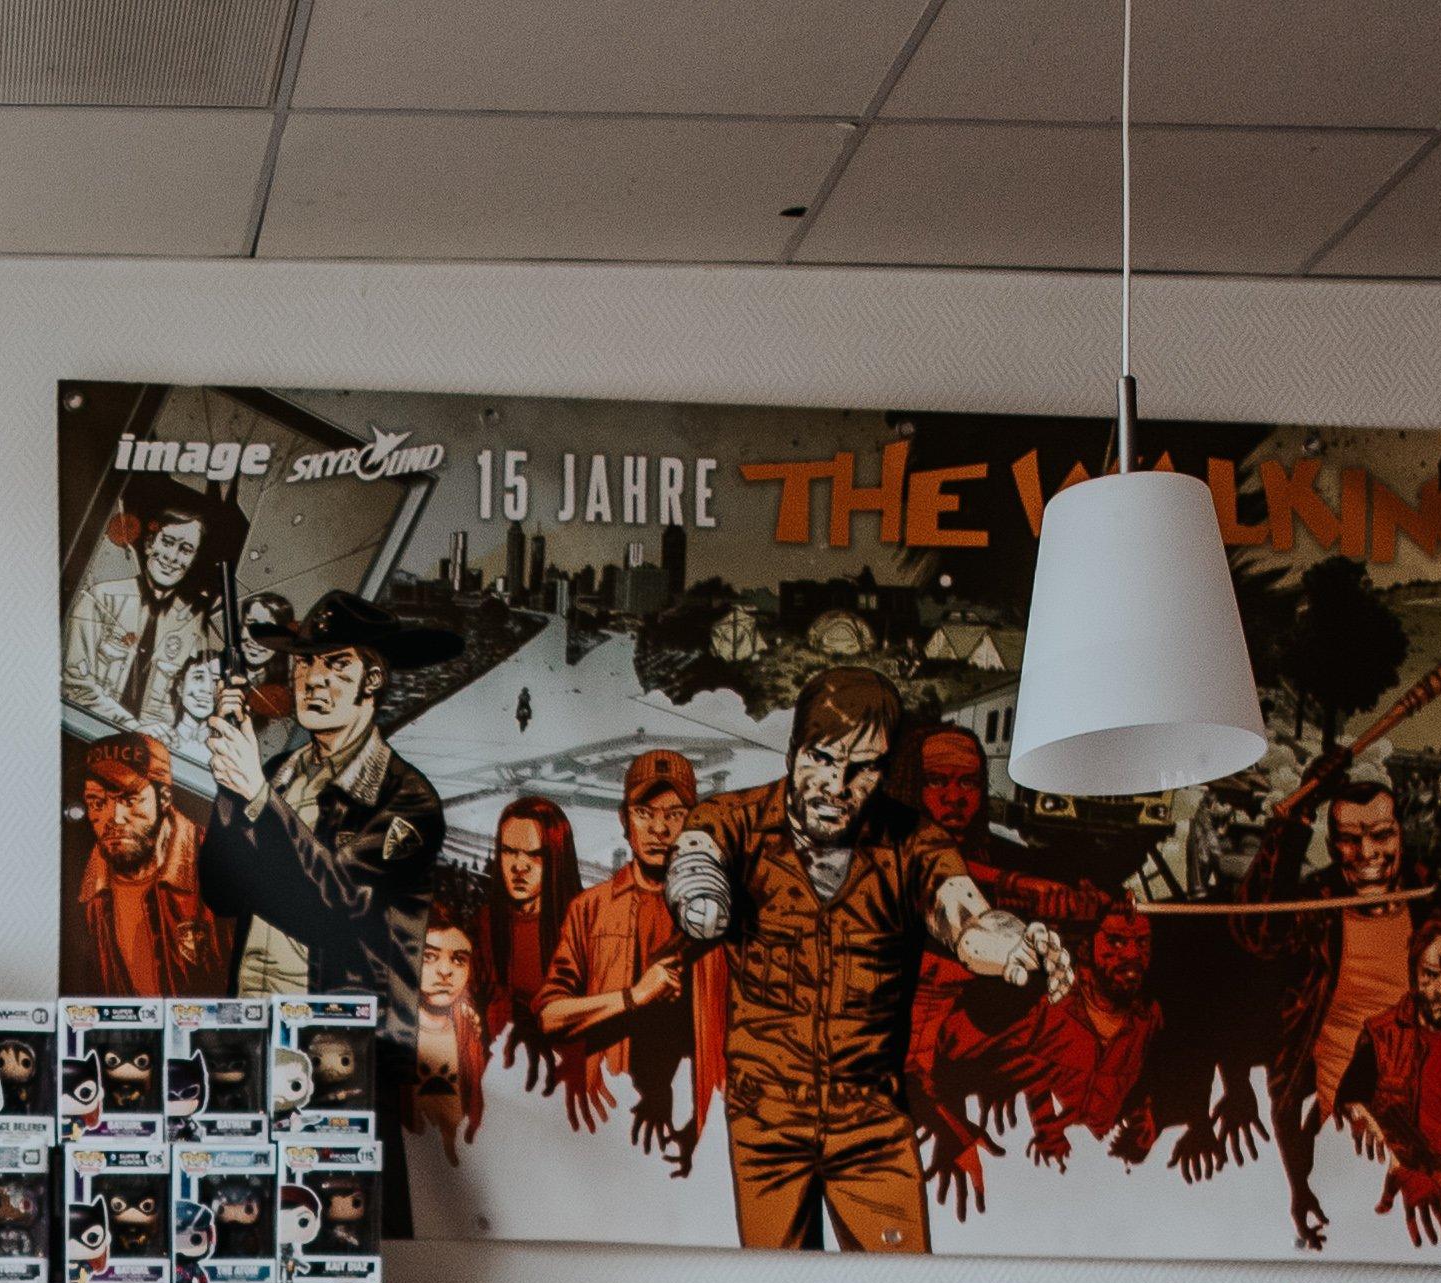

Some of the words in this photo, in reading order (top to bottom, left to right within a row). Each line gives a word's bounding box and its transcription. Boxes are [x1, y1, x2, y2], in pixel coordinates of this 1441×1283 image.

[114, 431, 273, 481] image
[285, 425, 445, 483] SKYBOUND
[477, 450, 526, 521] 15
[557, 453, 717, 527] JAHRE
[738, 438, 991, 548] THE
[86, 744, 145, 764] POLICE
